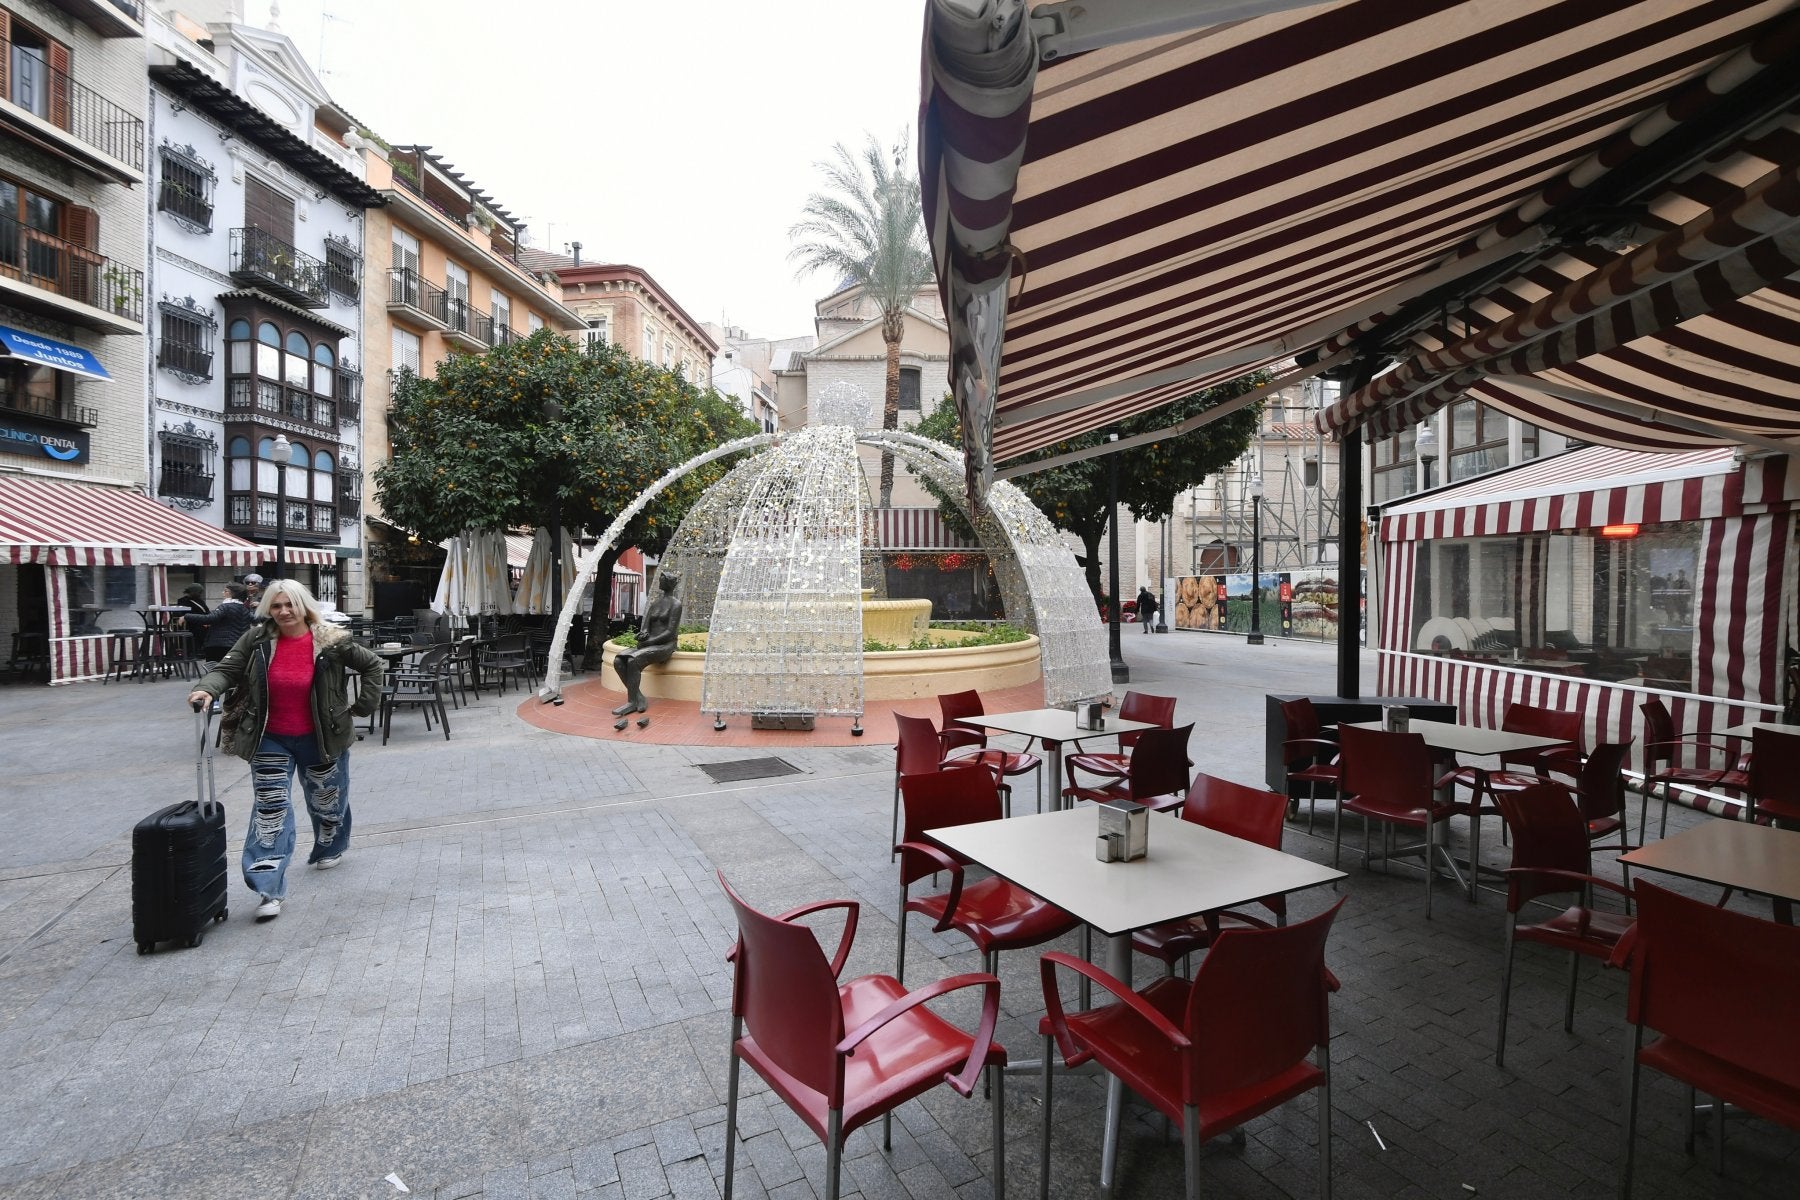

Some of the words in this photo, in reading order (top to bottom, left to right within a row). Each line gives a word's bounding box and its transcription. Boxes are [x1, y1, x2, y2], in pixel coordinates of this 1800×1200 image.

[11, 334, 52, 351] Desde
[54, 347, 84, 360] 1989
[33, 350, 85, 369] Juntos
[40, 435, 78, 449] DENTAL
